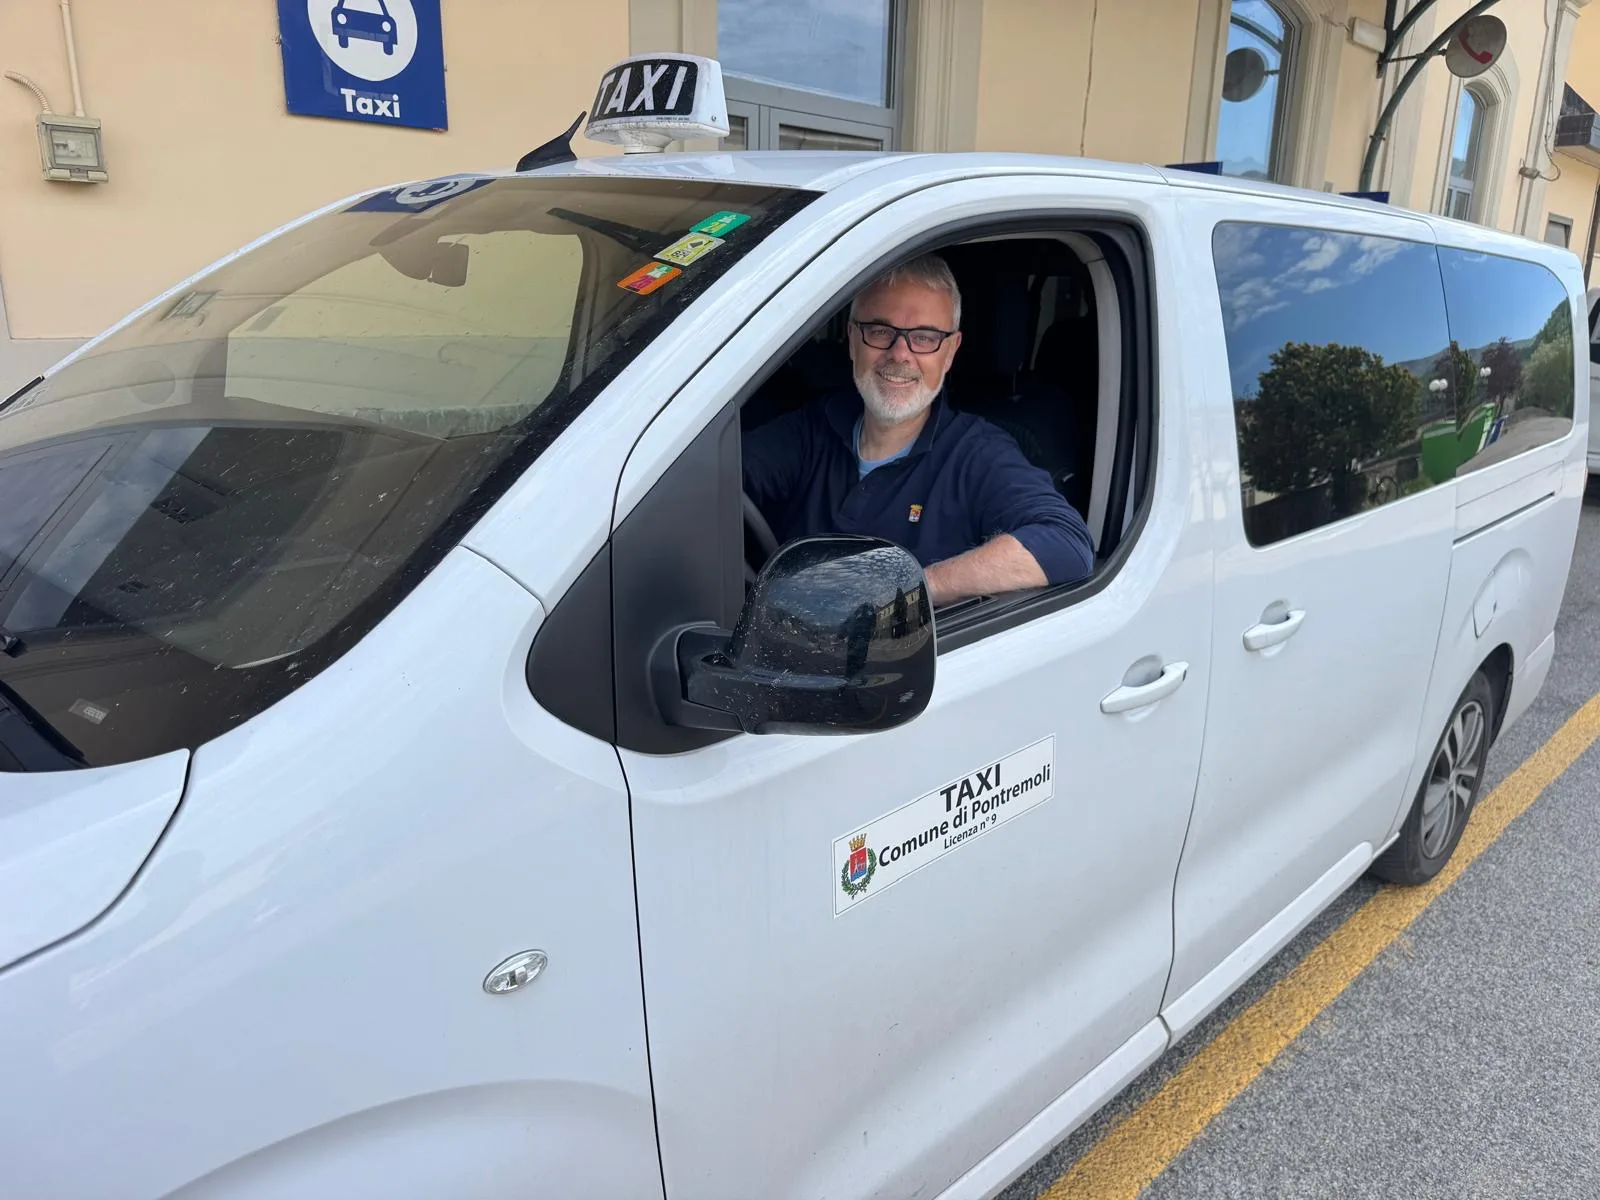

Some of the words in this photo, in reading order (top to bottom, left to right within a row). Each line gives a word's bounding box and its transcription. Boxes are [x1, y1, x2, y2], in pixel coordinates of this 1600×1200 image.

[340, 87, 400, 118] Taxi
[594, 64, 688, 116] TAXI
[940, 763, 1001, 813] TAXI
[879, 821, 949, 867] Comune
[953, 805, 968, 829] di
[972, 764, 1050, 820] Pontremoli
[944, 825, 978, 850] Licenza
[980, 816, 990, 831] n°
[991, 813, 997, 824] 9
